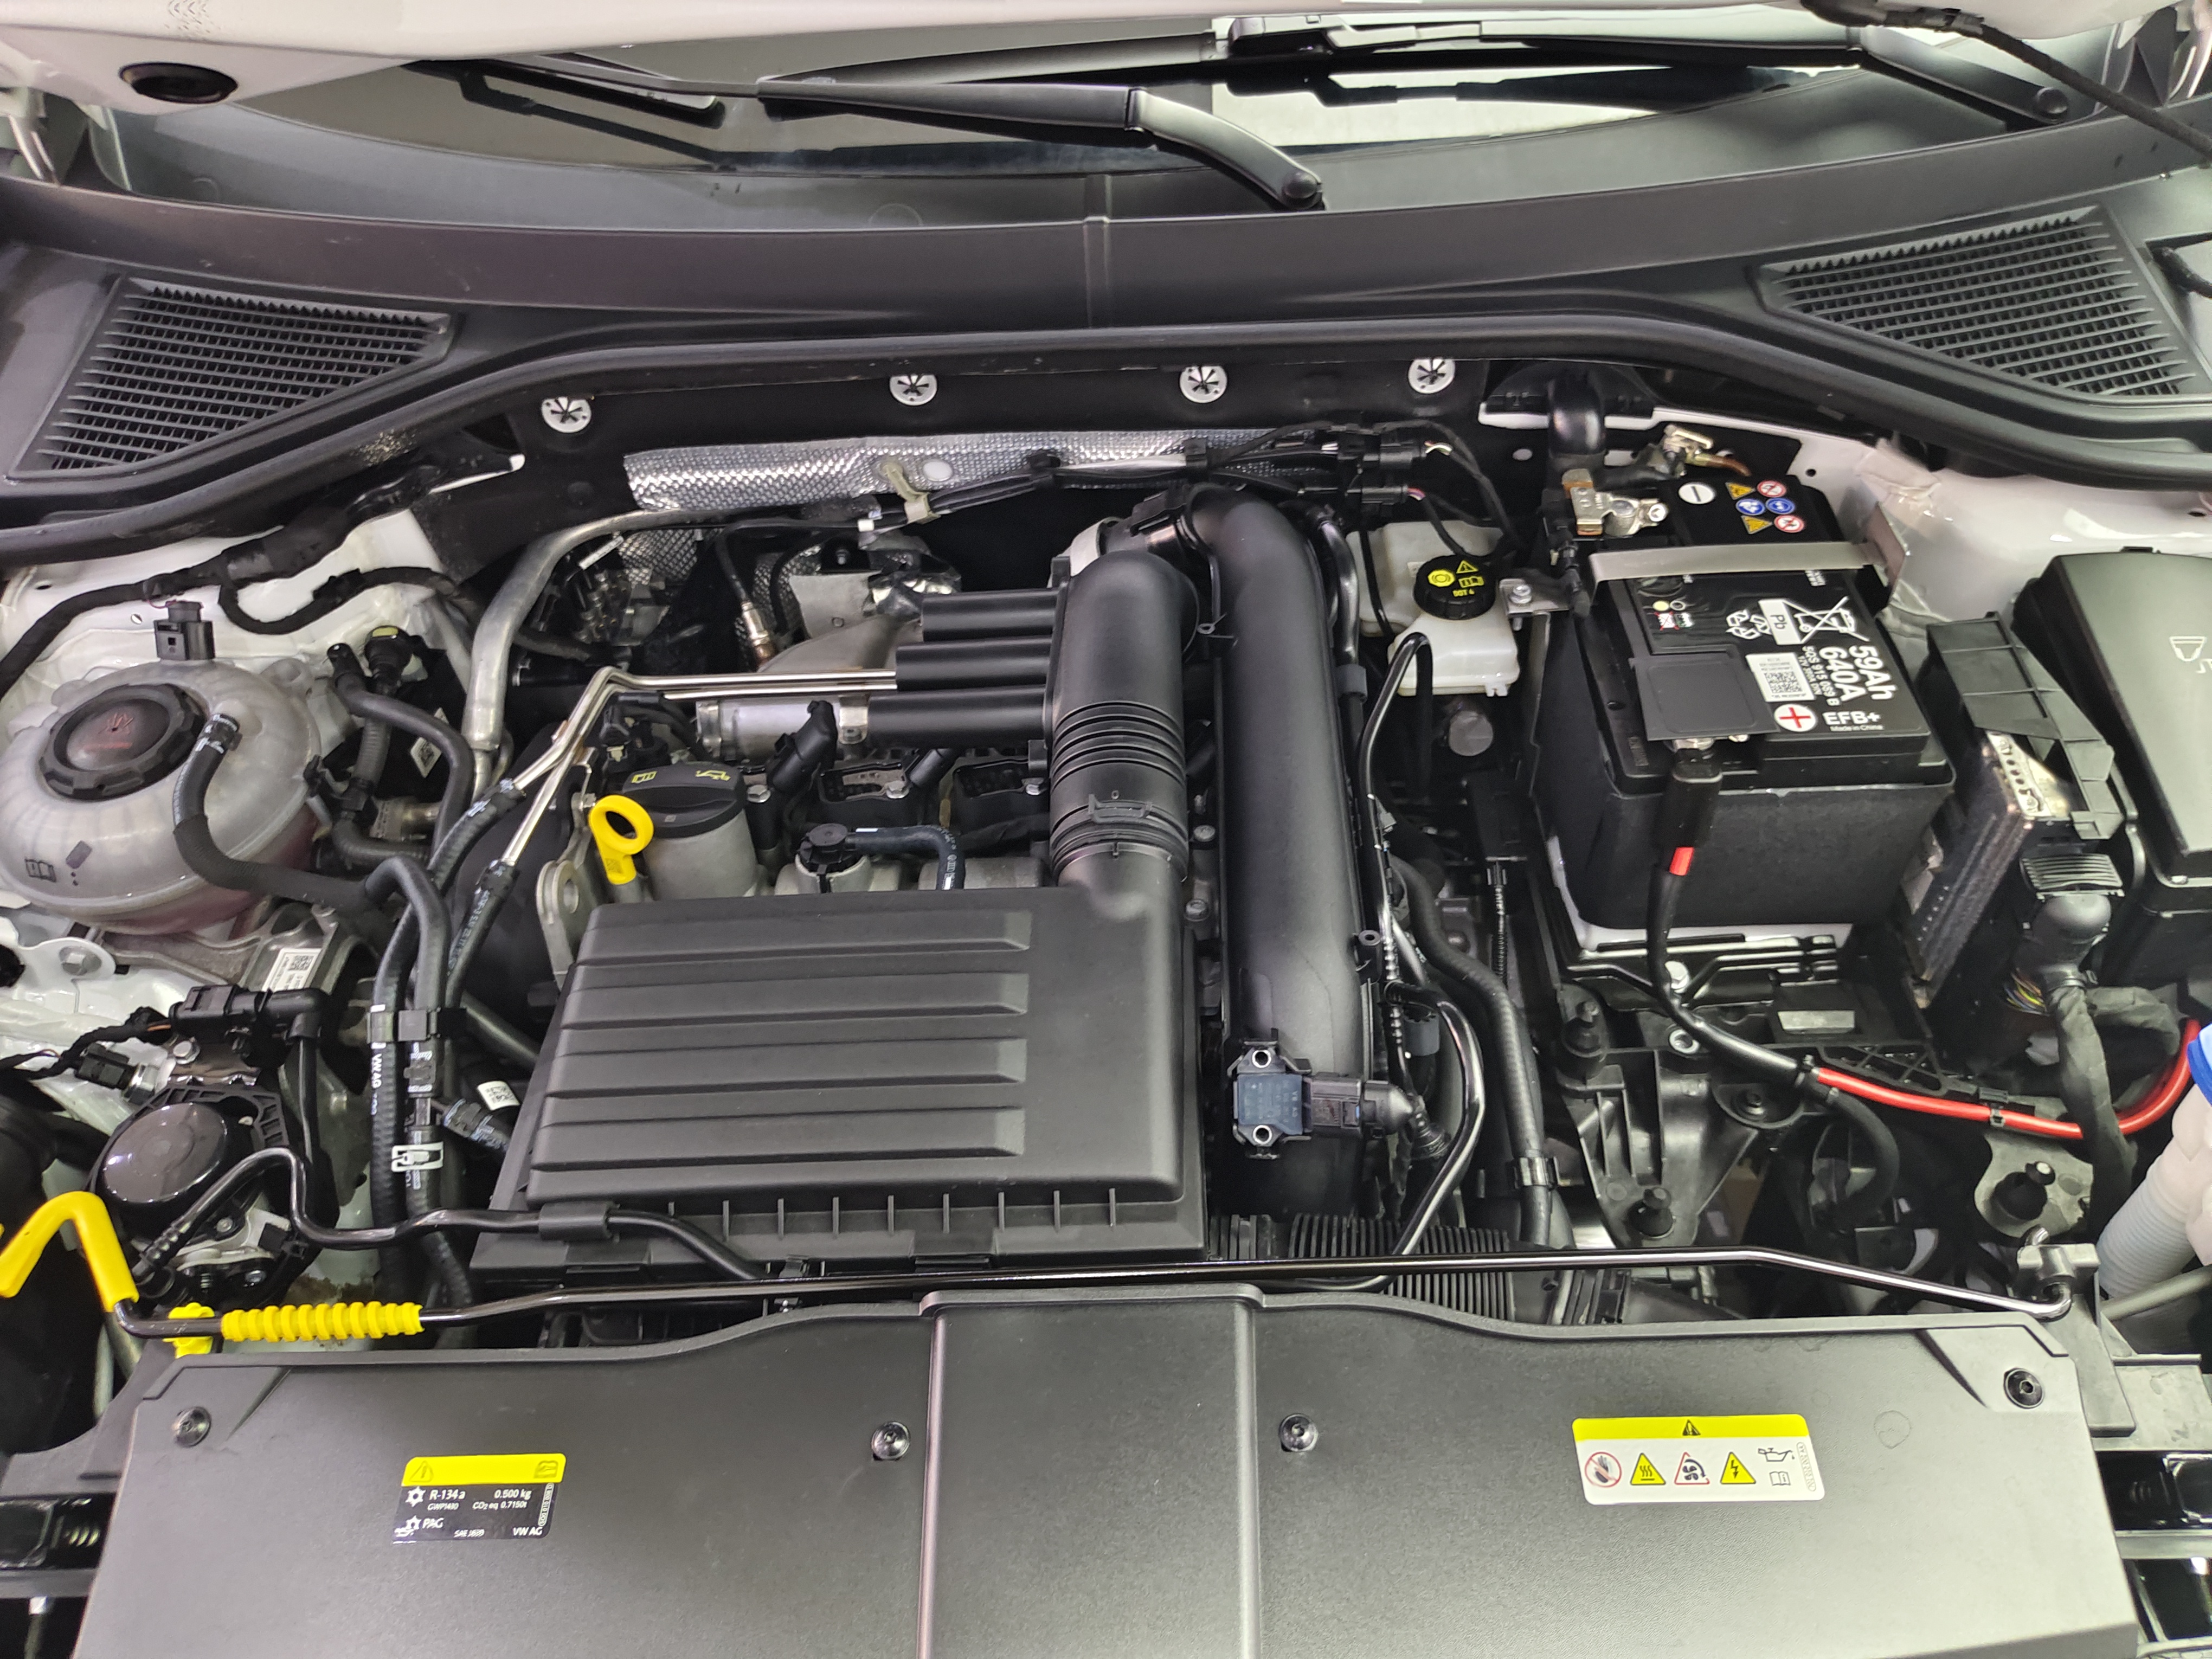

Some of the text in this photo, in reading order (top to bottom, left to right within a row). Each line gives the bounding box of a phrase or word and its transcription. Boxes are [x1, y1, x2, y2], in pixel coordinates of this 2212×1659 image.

[1770, 614, 1786, 631] Pb
[1819, 647, 1867, 701] 640A
[1849, 645, 1896, 699] 59Ah
[1811, 664, 1828, 680] 915
[1826, 698, 1840, 706] B
[1822, 711, 1881, 725] EFB+
[372, 1053, 382, 1072] VW
[371, 1072, 382, 1089] AG
[494, 1489, 519, 1499] 0.500
[520, 1488, 532, 1500] kg
[422, 1517, 444, 1529] PAG
[513, 1527, 530, 1536] VW
[528, 1527, 543, 1535] AG
